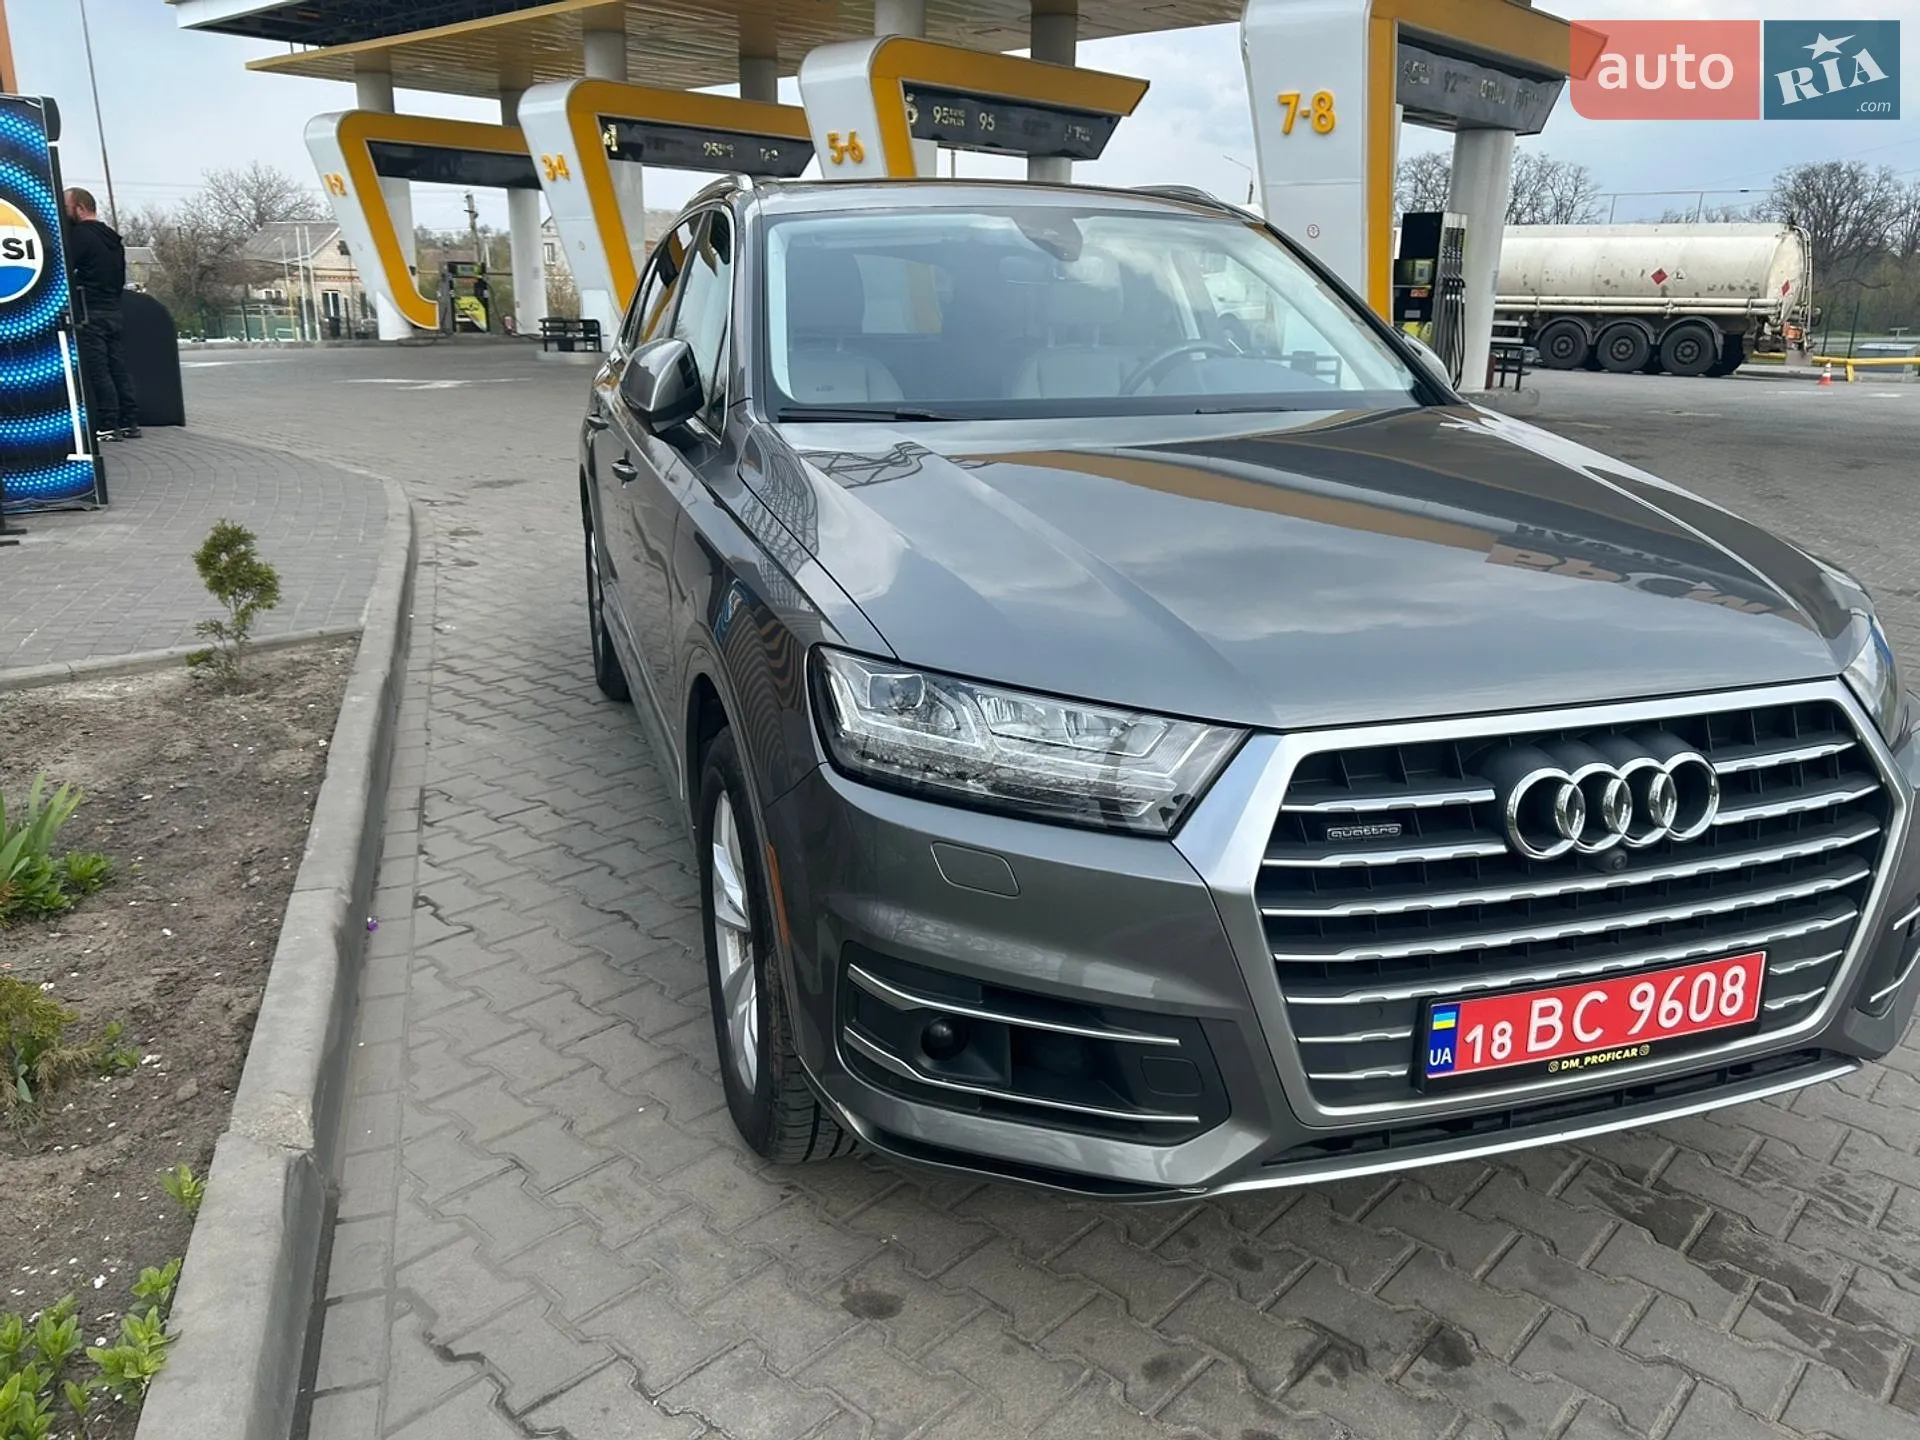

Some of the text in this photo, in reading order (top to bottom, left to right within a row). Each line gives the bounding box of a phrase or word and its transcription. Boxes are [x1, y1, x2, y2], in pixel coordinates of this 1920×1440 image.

[933, 106, 995, 131] 95 95
[1277, 90, 1336, 136] 7-8
[827, 129, 866, 166] 5-6
[1330, 827, 1399, 839] quattro
[1464, 964, 1747, 1065] 18 BC 9608
[1428, 1047, 1453, 1068] UA
